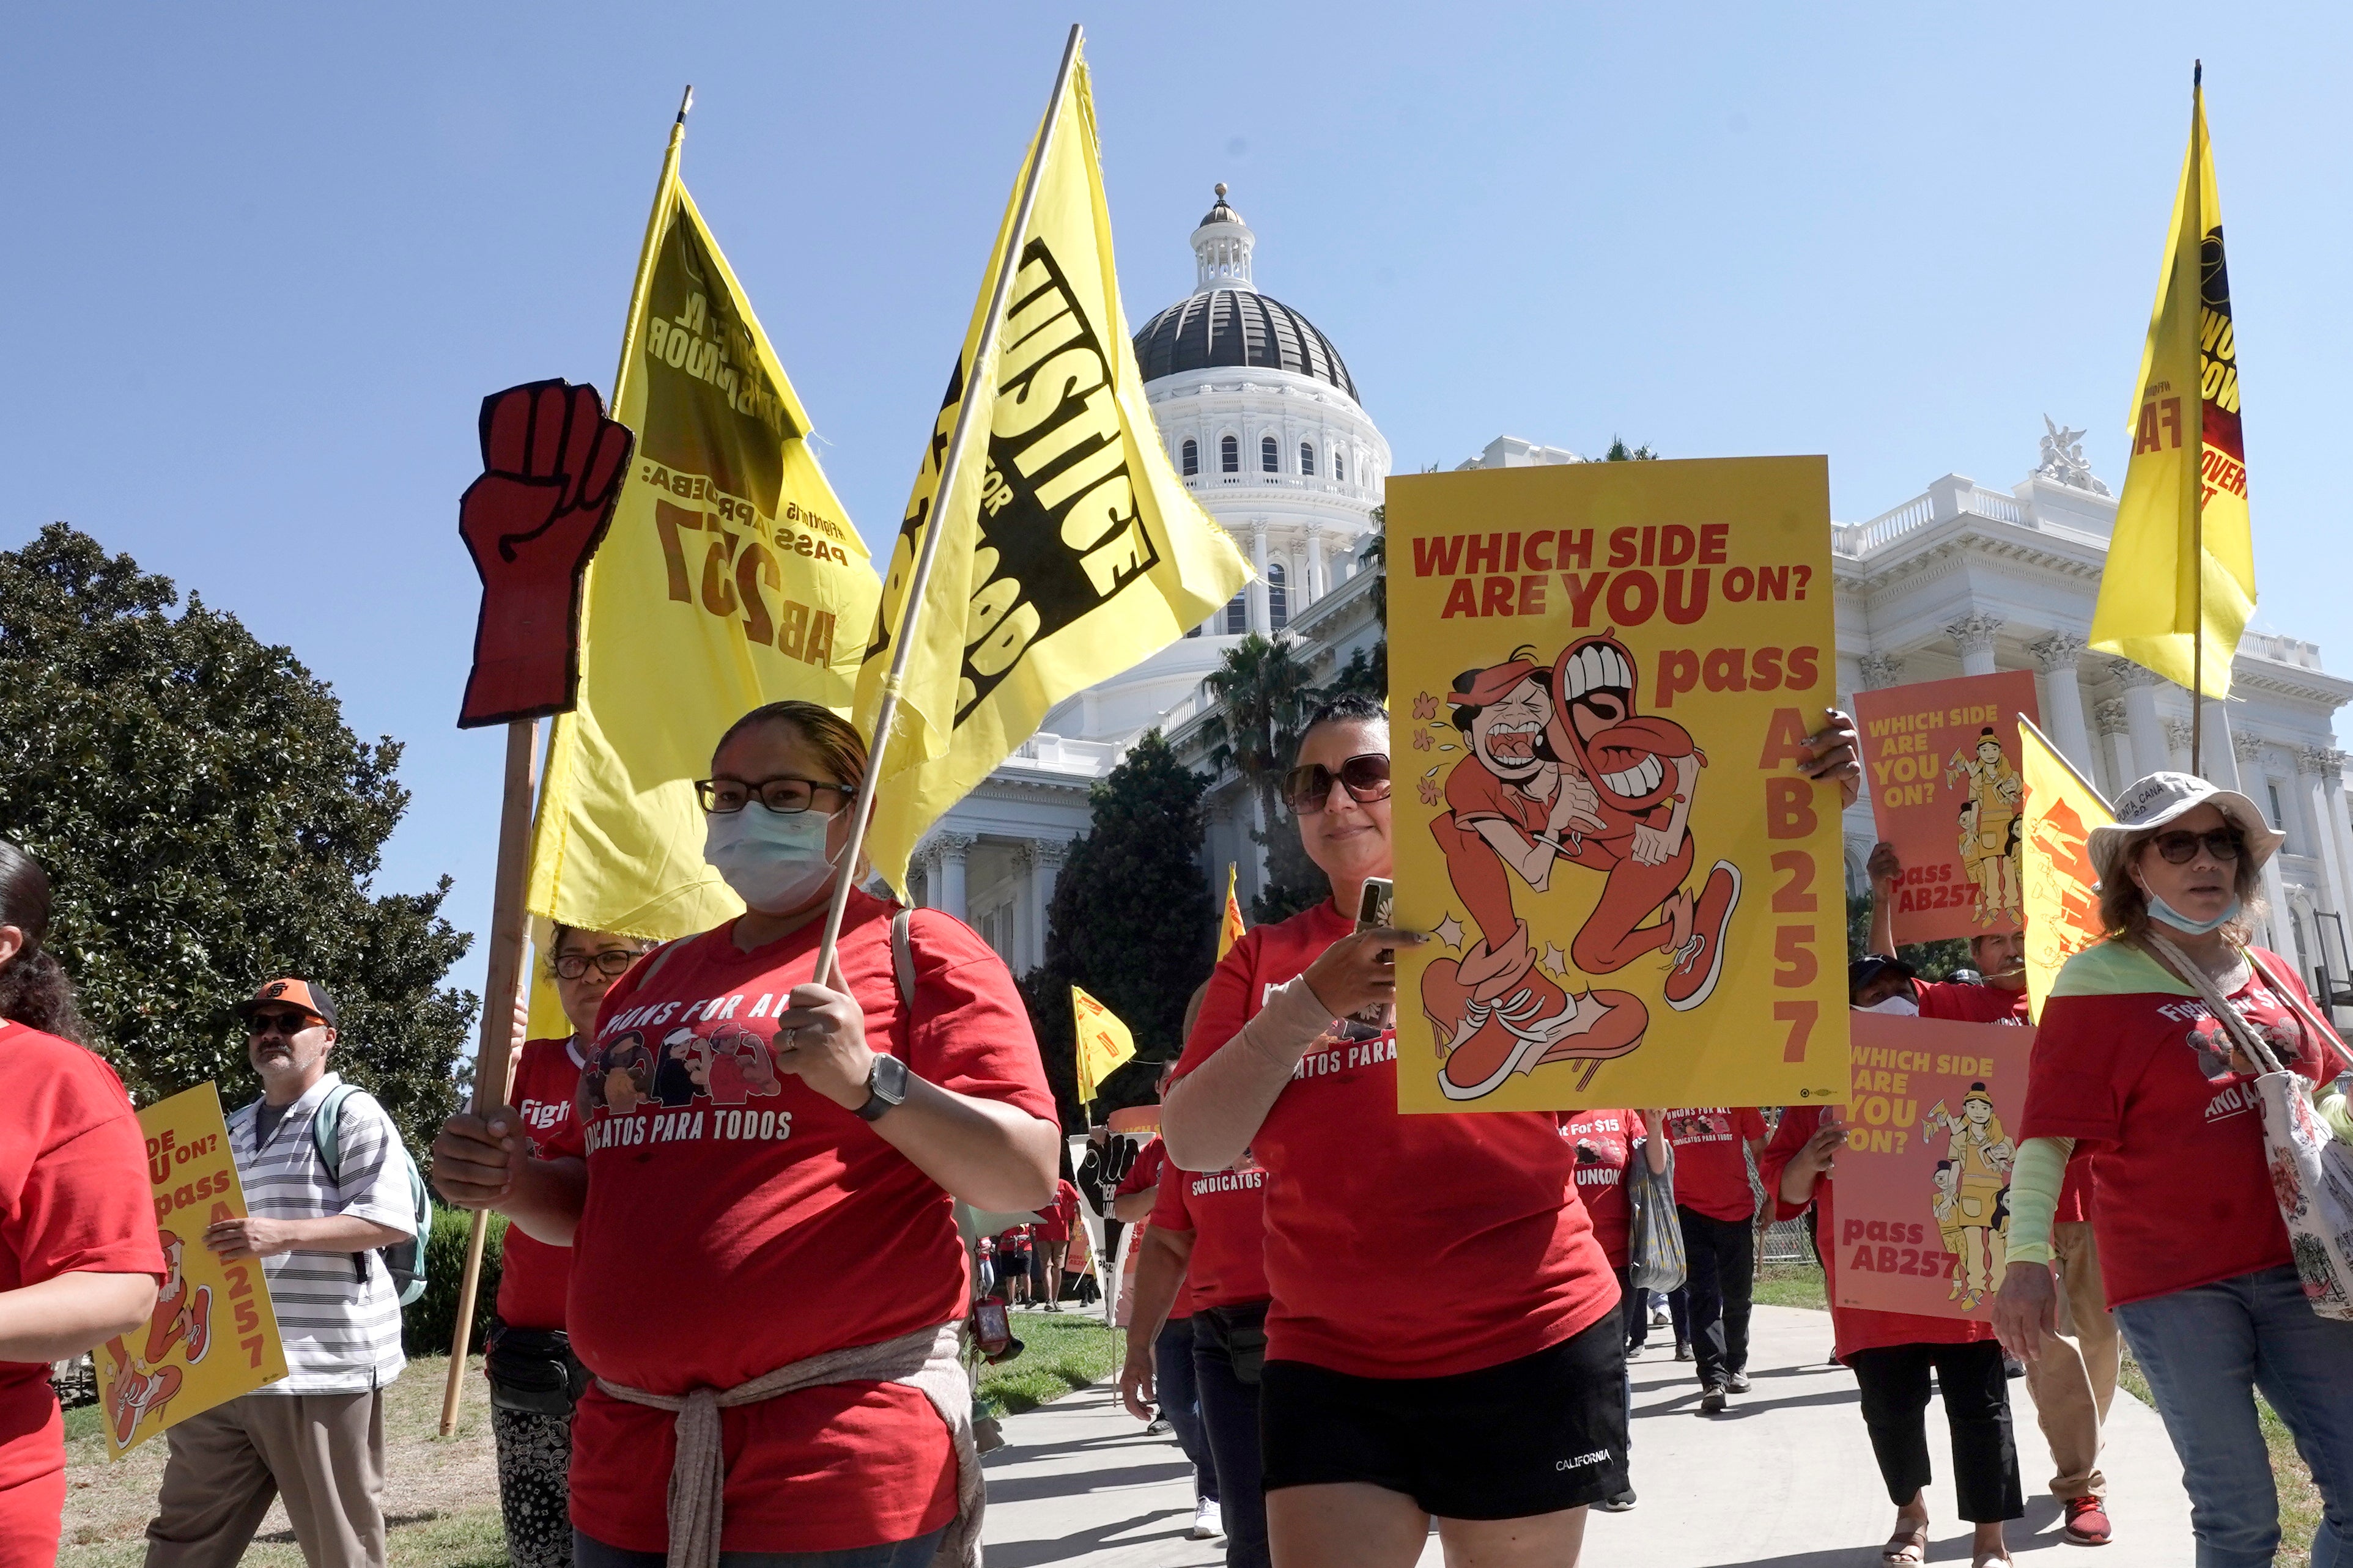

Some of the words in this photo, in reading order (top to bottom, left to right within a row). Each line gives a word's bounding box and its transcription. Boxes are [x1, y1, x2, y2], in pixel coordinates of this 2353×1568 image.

[1412, 528, 1594, 577] WHICH
[1608, 523, 1729, 569] SIDE
[1441, 575, 1548, 619] ARE
[1561, 568, 1711, 628] YOU
[1722, 565, 1812, 602] ON?
[1655, 644, 1819, 709] pass
[1868, 710, 1943, 738] WHICH
[1949, 704, 1998, 725] SIDE
[1881, 733, 1927, 757] ARE
[1872, 753, 1939, 786] YOU
[1884, 783, 1935, 808] ON?
[2116, 800, 2138, 823] PUNTA
[2138, 784, 2165, 804] CANA
[1892, 863, 1951, 894] pass
[1897, 883, 1980, 913] AB257
[680, 993, 744, 1023] FOR
[747, 993, 789, 1019] AL
[1348, 1037, 1397, 1069] PARA
[1850, 1045, 1930, 1072] WHICH
[1937, 1054, 1994, 1078] SIDE
[1853, 1069, 1909, 1095] ARE
[1842, 1094, 1918, 1128] YOU
[2205, 1087, 2242, 1118] AND
[649, 1111, 704, 1144] PARA
[714, 1110, 793, 1141] TODOS
[1571, 1123, 1594, 1136] For
[1595, 1119, 1620, 1133] $15
[1846, 1127, 1908, 1154] ON?
[175, 1133, 218, 1165] ON?
[155, 1169, 231, 1227] pass
[1192, 1172, 1262, 1196] SINDICATOS
[1842, 1218, 1924, 1246] pass
[1850, 1245, 1960, 1280] AB257
[210, 1200, 265, 1369] A257
[1556, 1448, 1614, 1471] CALIFORNIA
